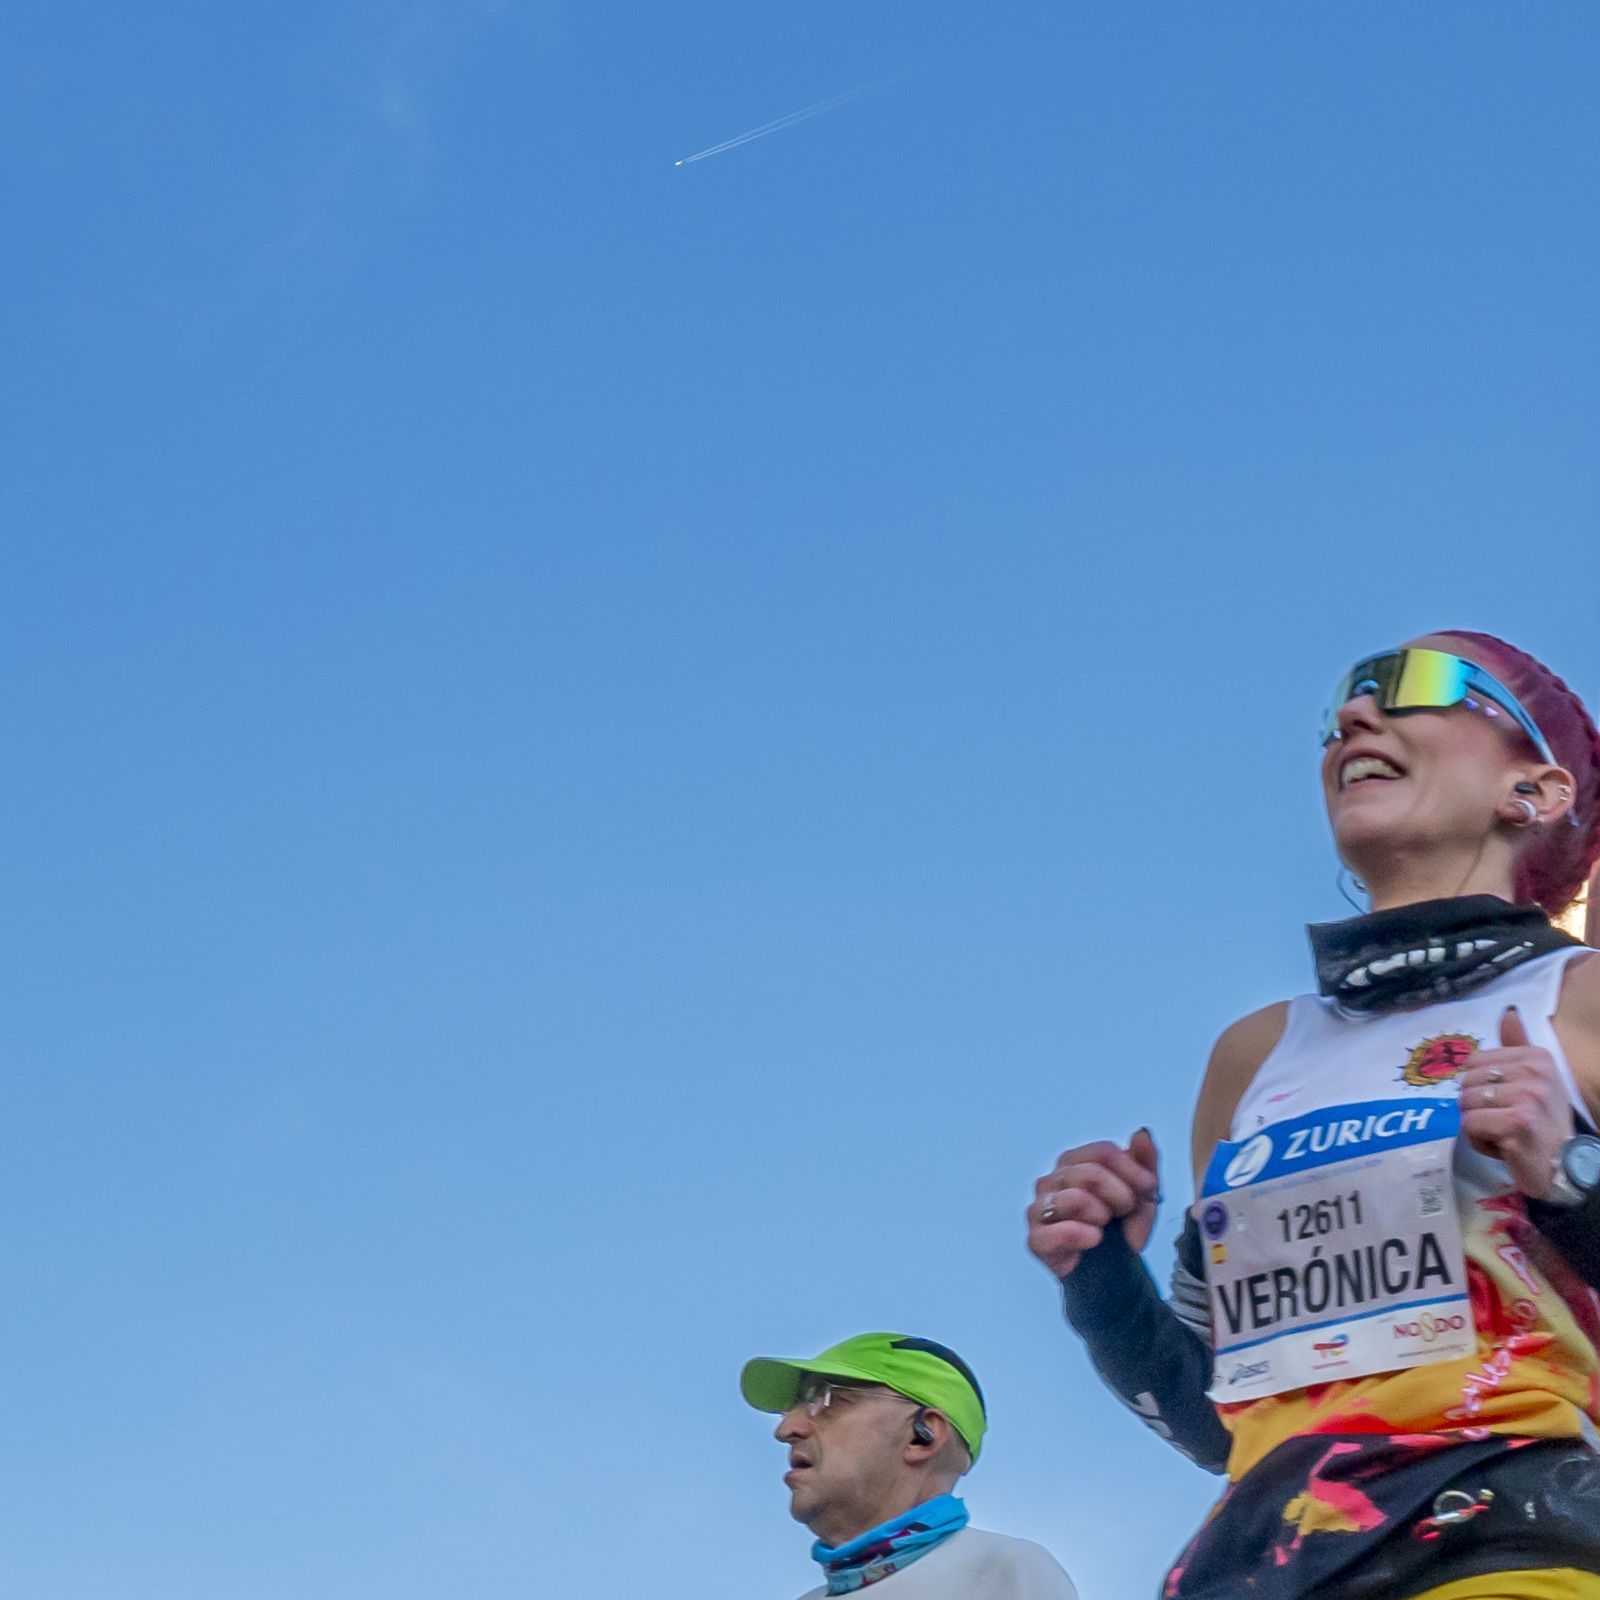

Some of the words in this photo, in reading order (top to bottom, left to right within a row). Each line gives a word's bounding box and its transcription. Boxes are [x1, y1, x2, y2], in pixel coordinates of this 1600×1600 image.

[1282, 1108, 1434, 1160] ZURICH
[1277, 1190, 1363, 1242] 12611
[1217, 1232, 1453, 1335] VERÓNICA
